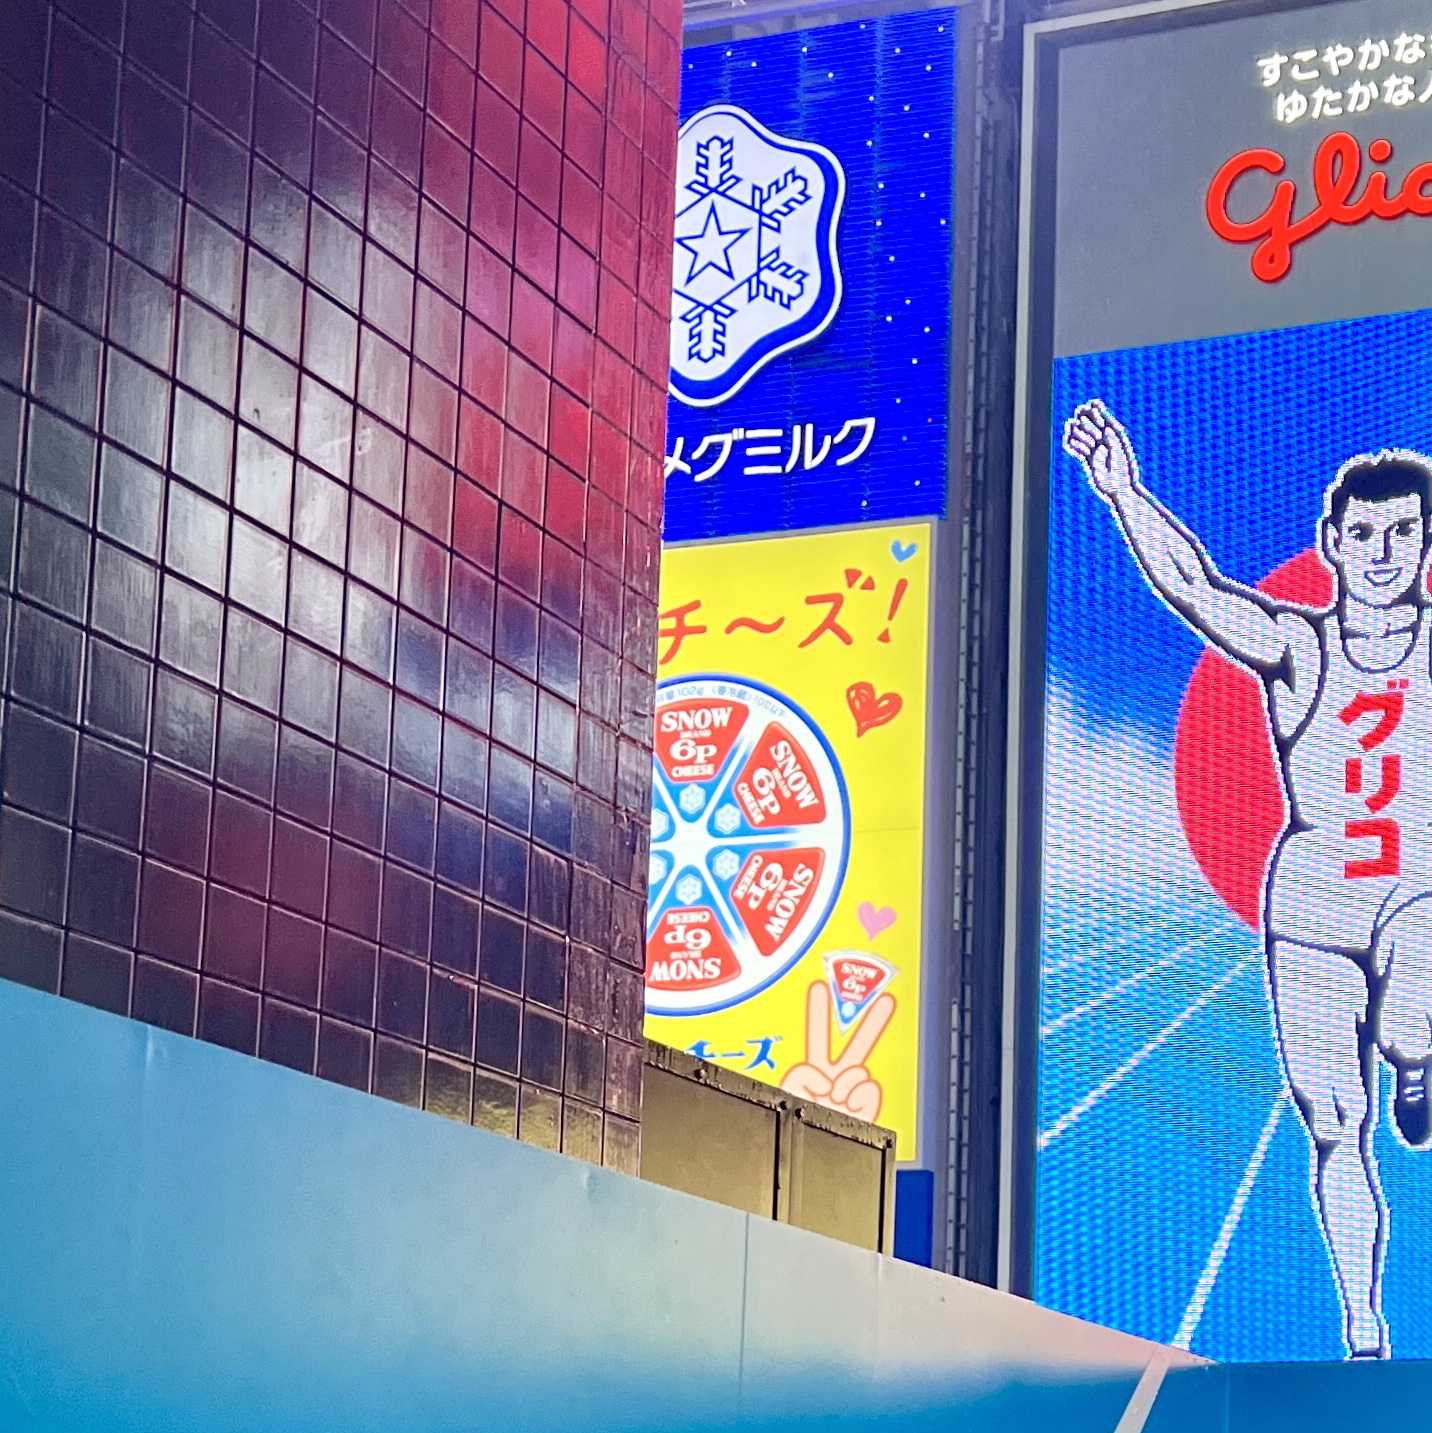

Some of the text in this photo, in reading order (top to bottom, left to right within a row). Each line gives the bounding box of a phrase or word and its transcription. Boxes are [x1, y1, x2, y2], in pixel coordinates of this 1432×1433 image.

[661, 707, 733, 732] SNOW
[671, 764, 715, 777] CHEESE
[769, 740, 819, 809] SNOW
[1336, 678, 1409, 879] グリコ
[737, 782, 765, 825] CHEESE
[733, 855, 763, 899] CHEESE
[667, 911, 710, 925] CHEESE
[765, 863, 815, 941] SNOW
[649, 958, 721, 982] SNOW
[841, 962, 879, 979] SNOW
